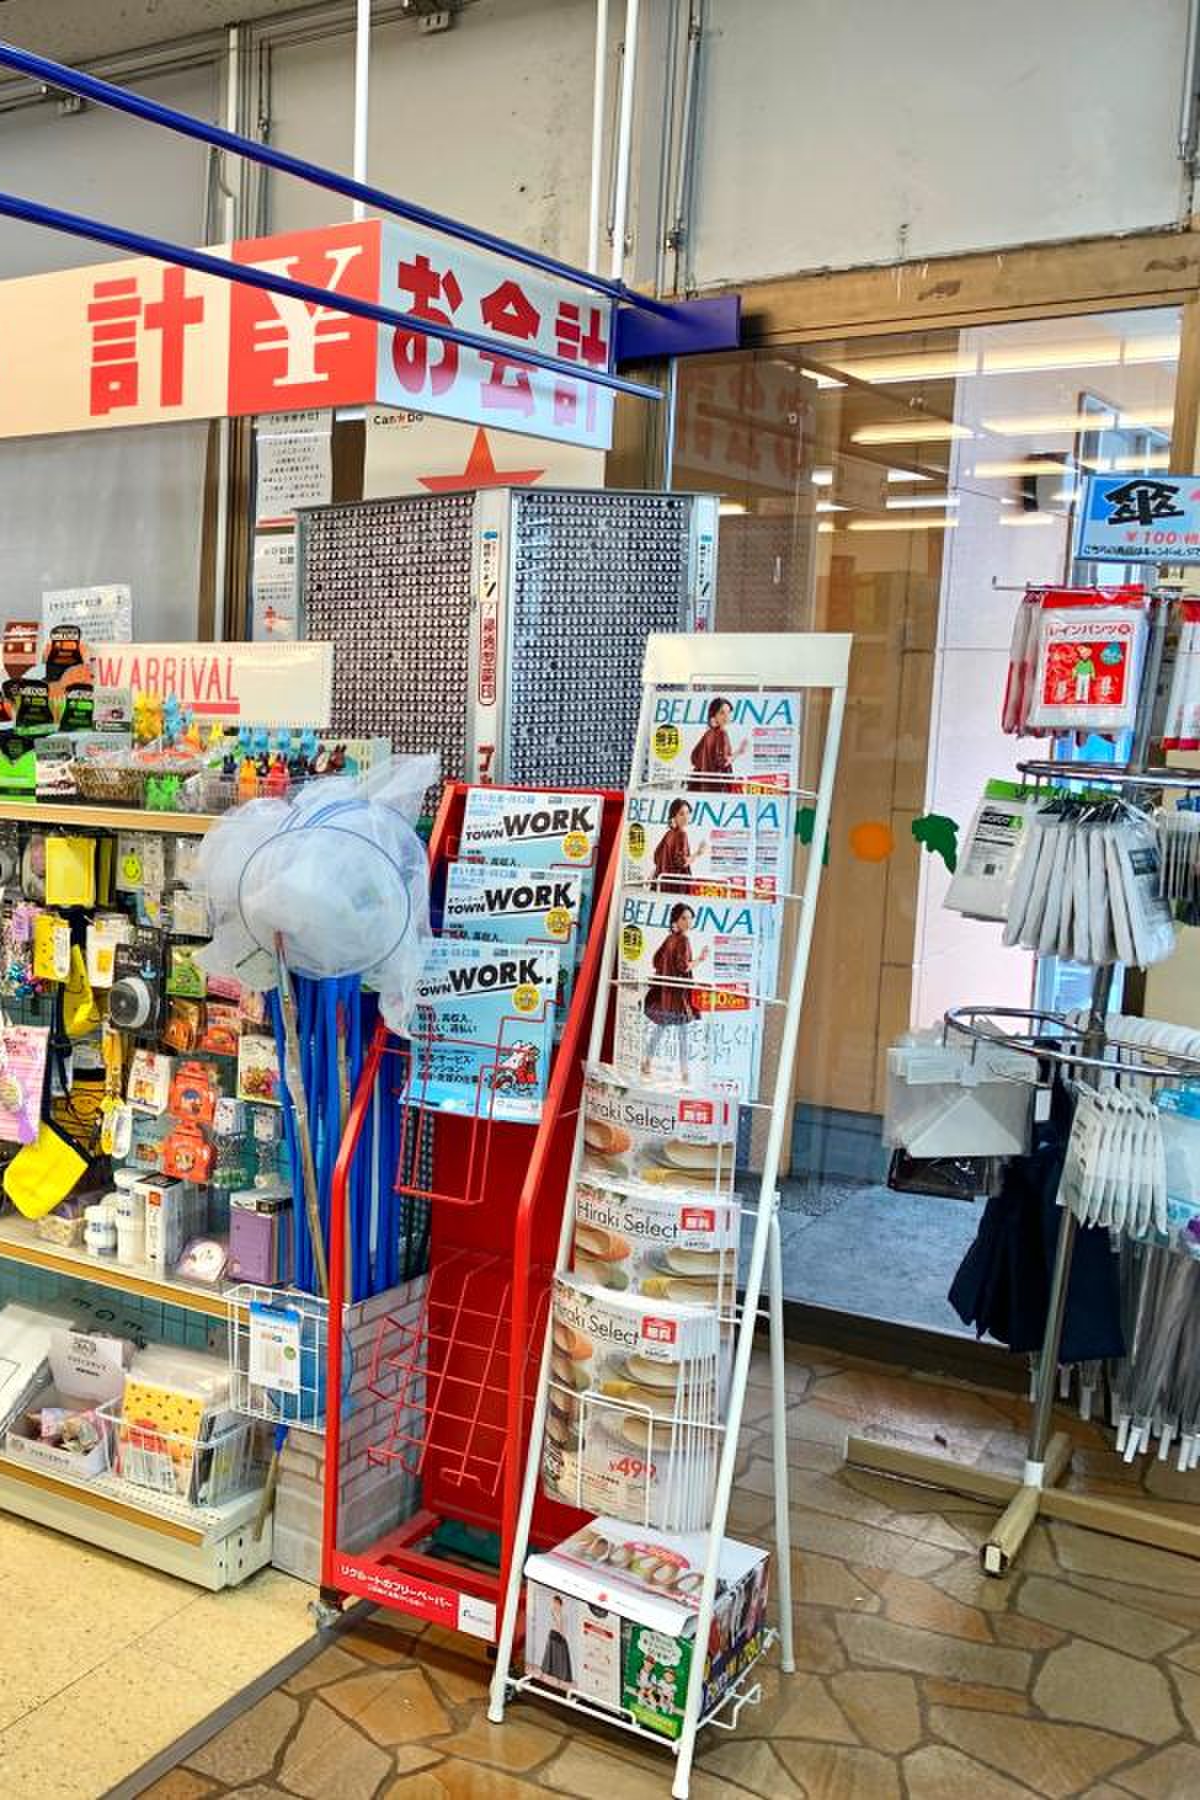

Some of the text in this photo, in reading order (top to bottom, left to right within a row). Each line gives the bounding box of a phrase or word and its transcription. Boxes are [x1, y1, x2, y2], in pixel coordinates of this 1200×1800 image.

[392, 253, 608, 433] お会計
[1103, 479, 1186, 526] 傘
[654, 697, 794, 725] BELLNA
[466, 805, 594, 841] TOWN WORK
[627, 798, 750, 828] BELLNA
[448, 882, 576, 915] TOWN WORK
[622, 898, 753, 935] BELLNA
[416, 957, 543, 997] OWN WORK
[623, 1105, 676, 1132] Select
[577, 1200, 678, 1239] Hiraki Select
[588, 1315, 640, 1346] Select
